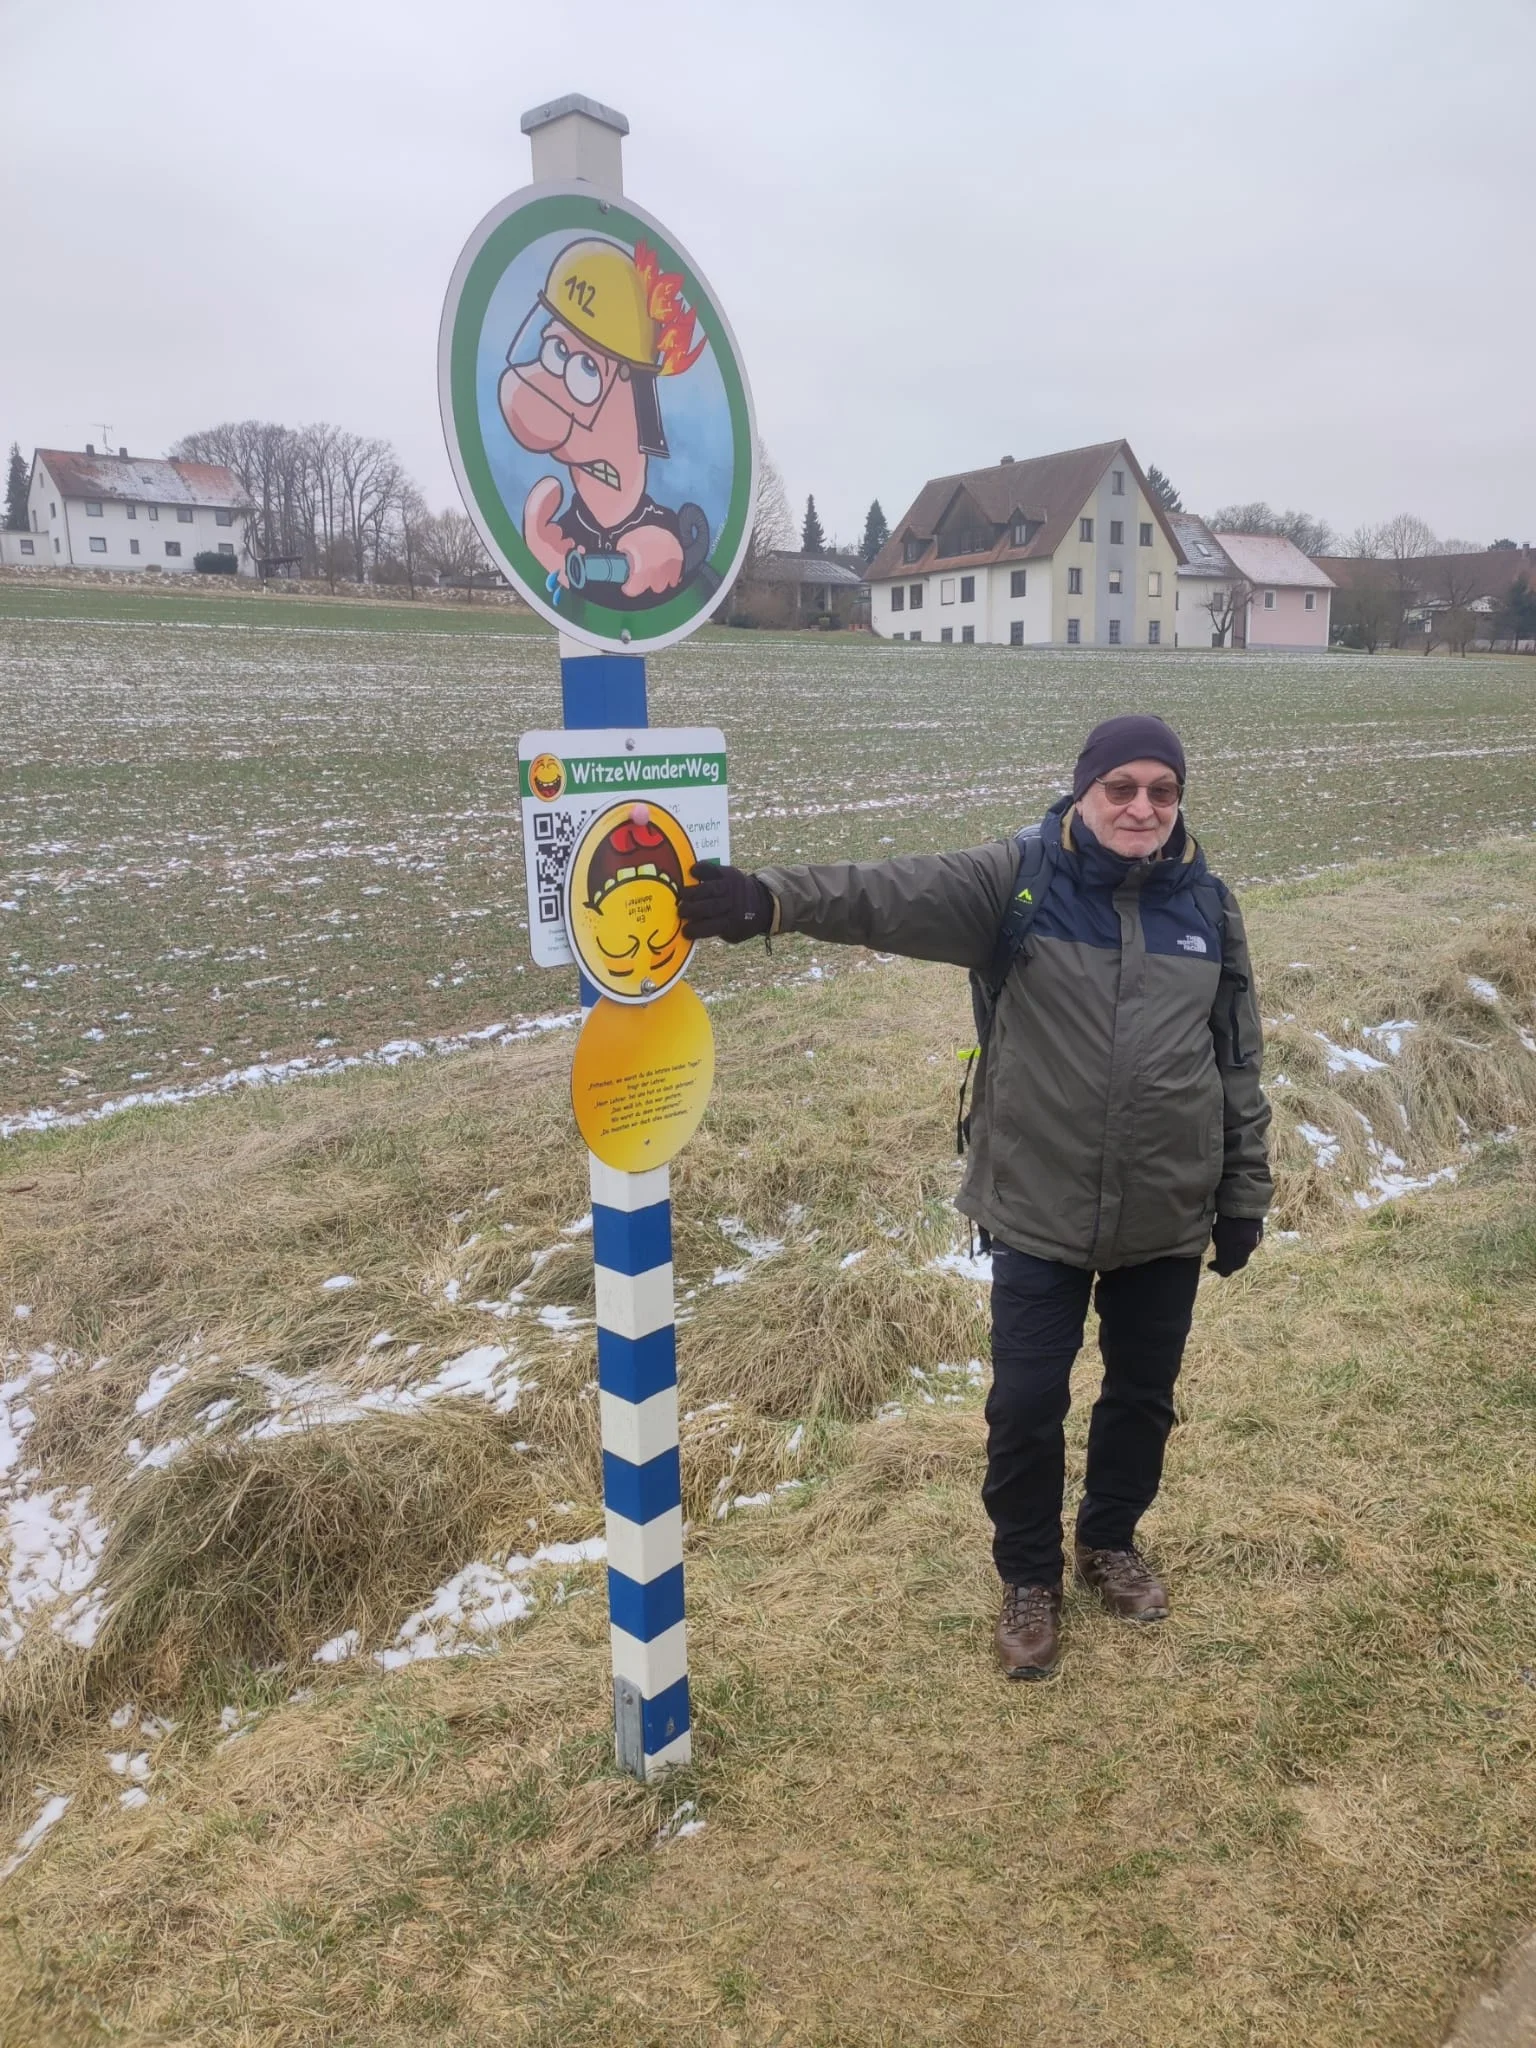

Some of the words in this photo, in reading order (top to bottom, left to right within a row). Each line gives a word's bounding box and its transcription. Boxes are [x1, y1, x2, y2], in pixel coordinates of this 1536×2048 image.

[564, 275, 596, 318] 112
[571, 758, 719, 784] WitzeWanderWeg
[686, 818, 721, 832] erwehr
